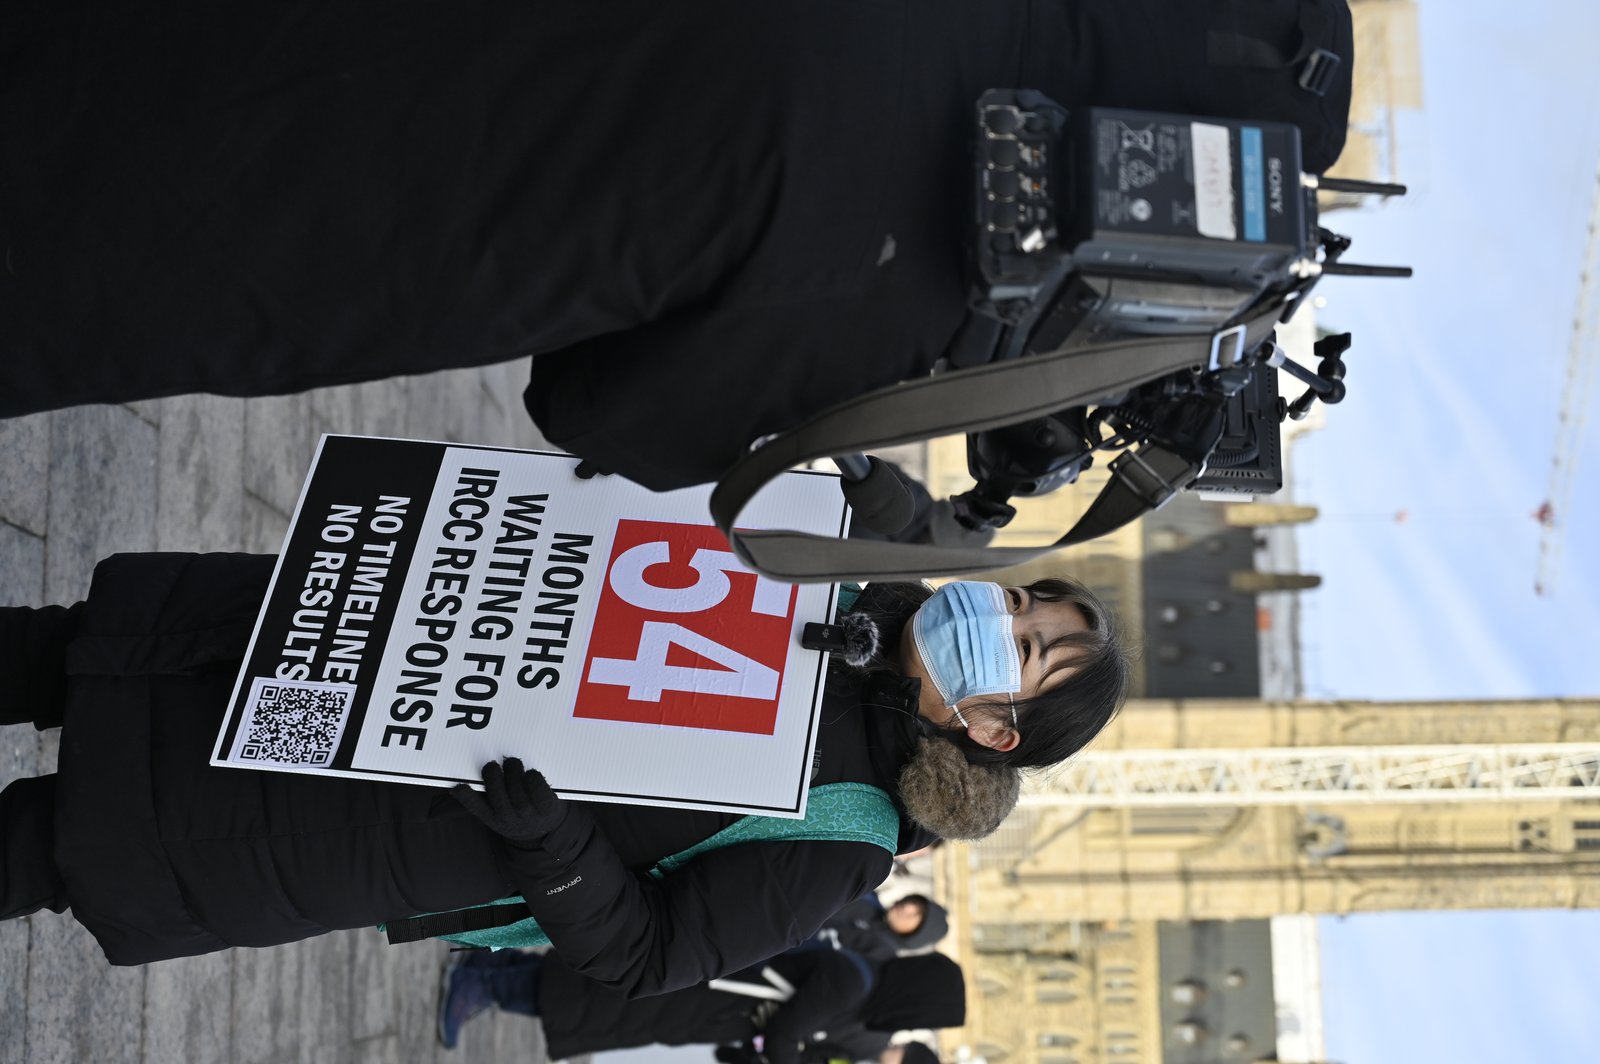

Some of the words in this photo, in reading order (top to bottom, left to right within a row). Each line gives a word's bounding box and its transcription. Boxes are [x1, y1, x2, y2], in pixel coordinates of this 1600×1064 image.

[1268, 157, 1284, 215] SONY
[321, 504, 363, 543] NO
[370, 495, 411, 534] NO
[442, 467, 500, 542] IRCC
[275, 551, 347, 681] RESULTS
[322, 541, 397, 683] TIMELINE
[469, 494, 549, 641] WAITING
[517, 533, 594, 690] MONTHS
[381, 547, 477, 751] RESPONSE
[587, 541, 793, 703] 54
[446, 652, 506, 730] FOR
[546, 875, 582, 896] DRYVENT
